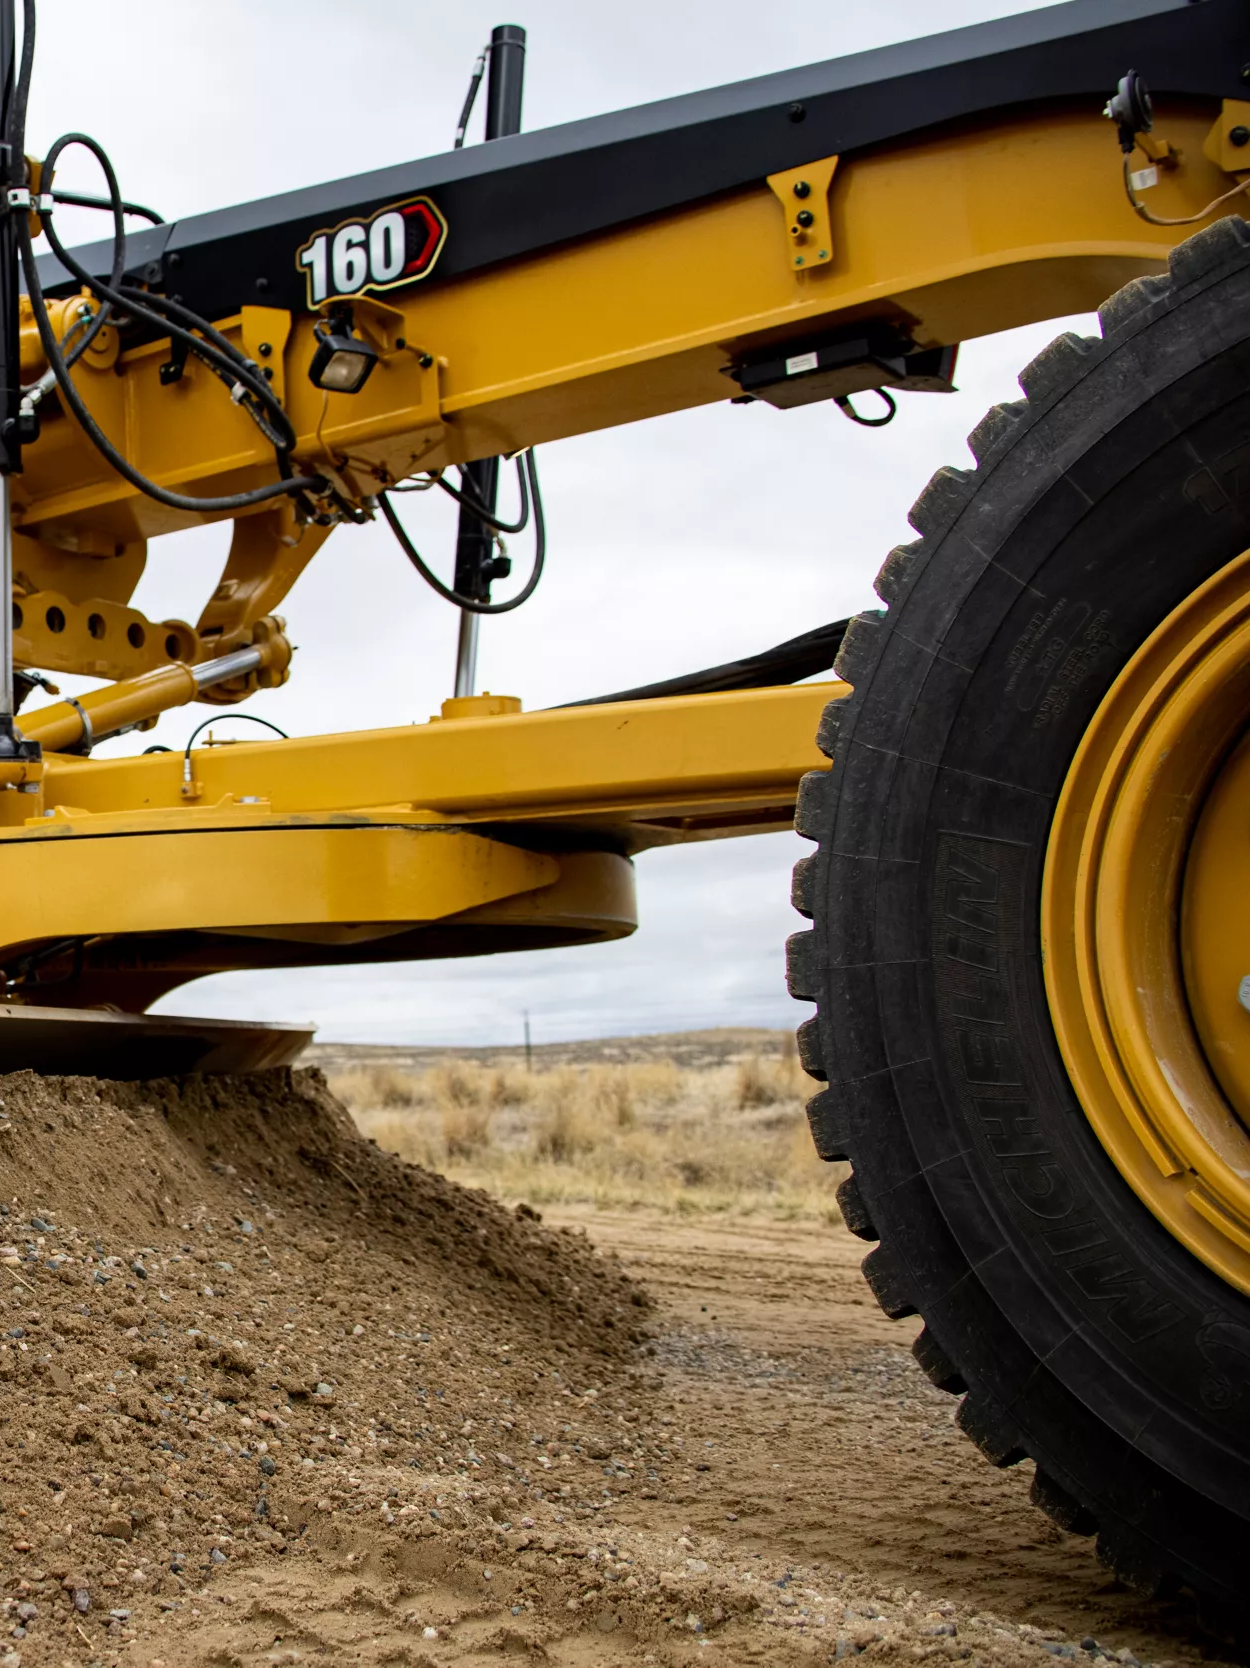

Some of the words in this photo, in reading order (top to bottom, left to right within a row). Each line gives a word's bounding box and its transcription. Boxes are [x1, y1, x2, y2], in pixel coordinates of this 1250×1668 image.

[302, 212, 406, 301] 160
[1034, 685, 1062, 725] RADIAL
[1058, 646, 1086, 680] STEEL
[1084, 609, 1111, 641] CORD
[1067, 664, 1088, 687] THE
[1084, 630, 1110, 661] ROAD
[945, 847, 1186, 1343] MICHELIN
